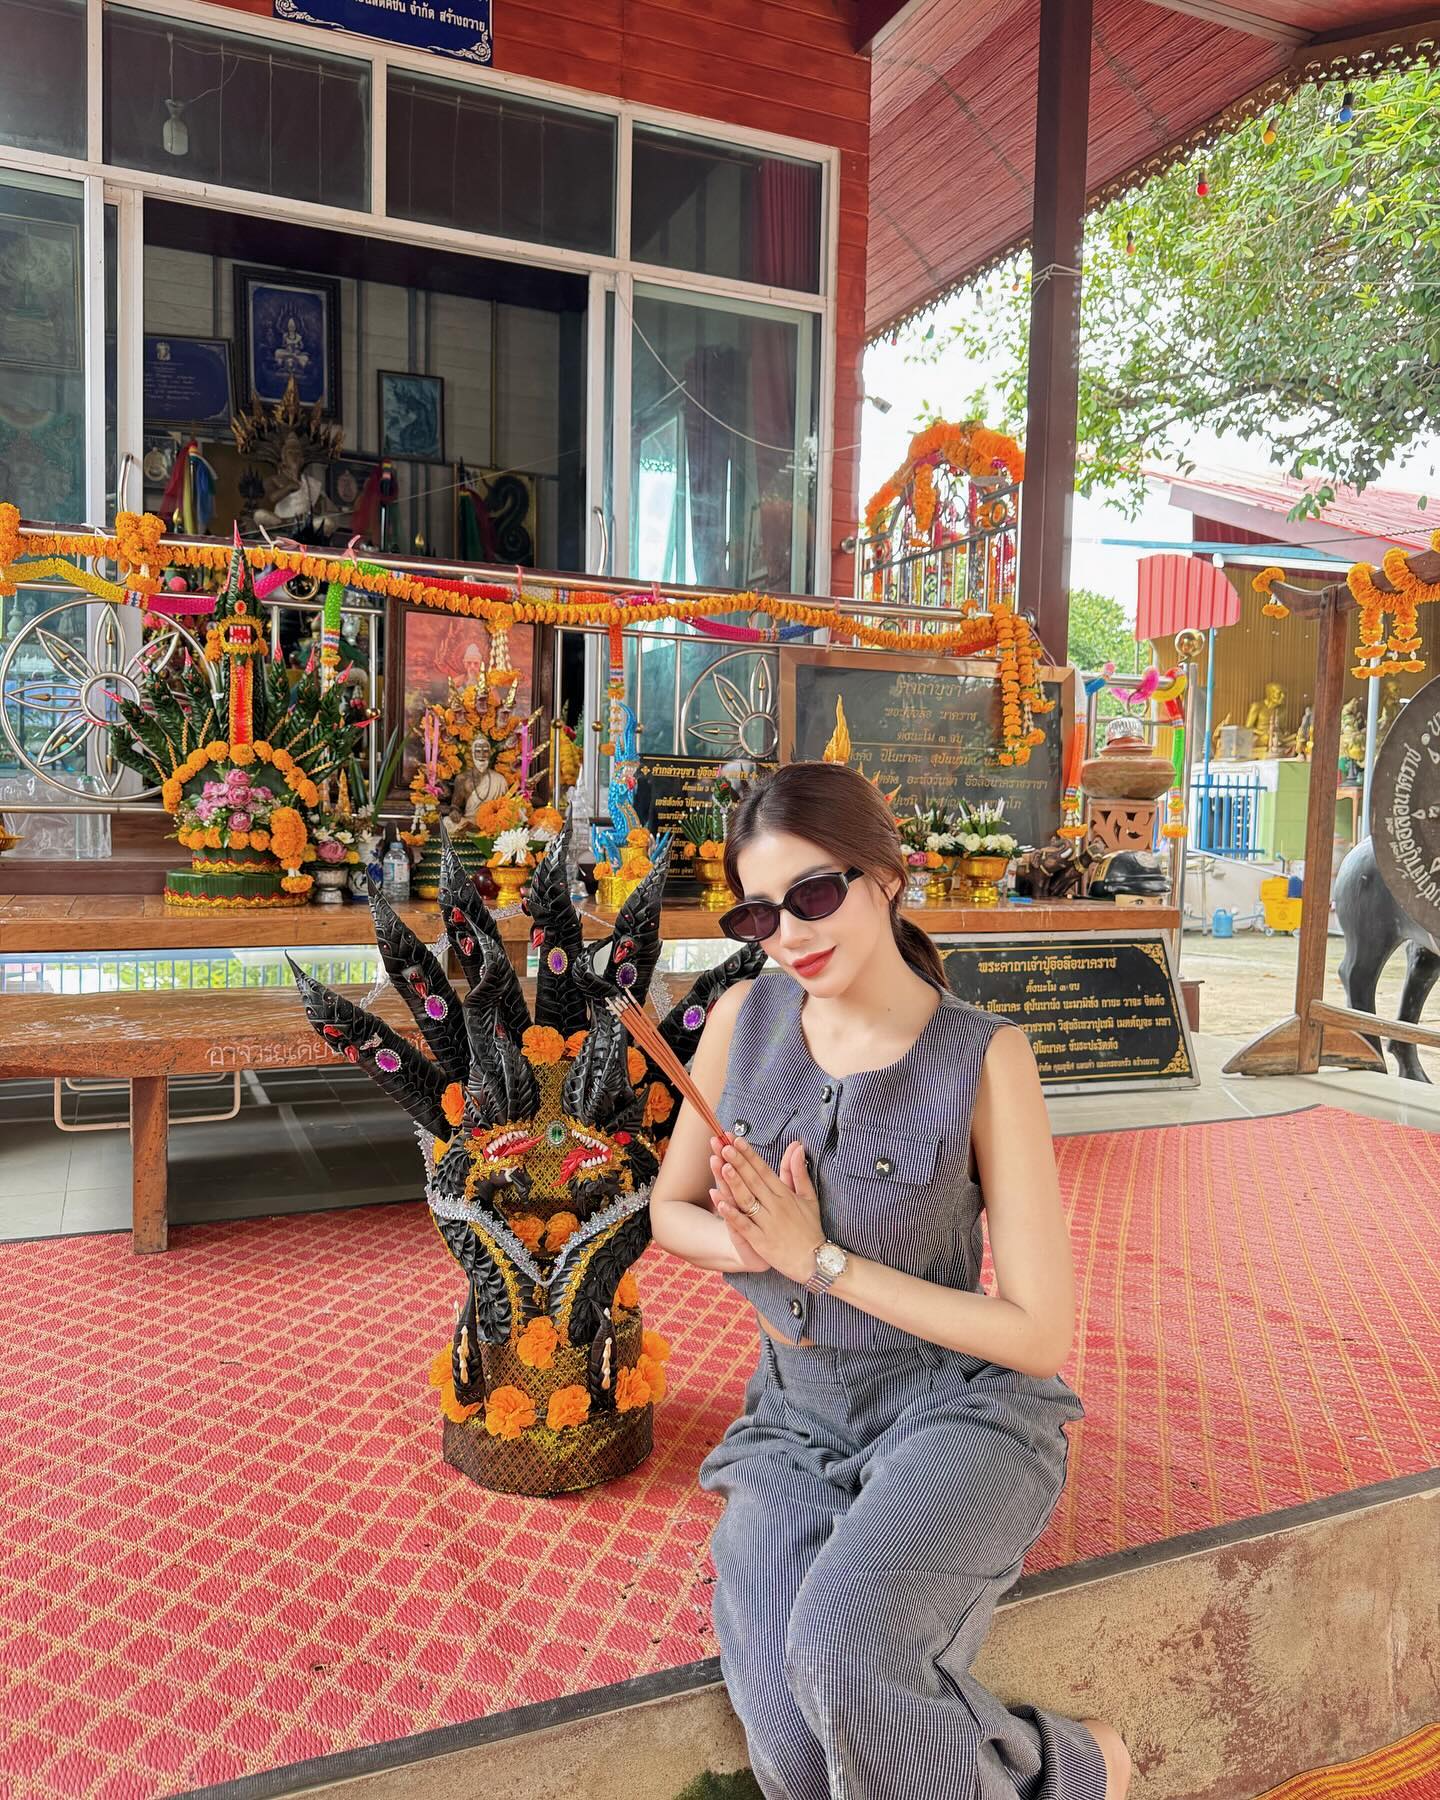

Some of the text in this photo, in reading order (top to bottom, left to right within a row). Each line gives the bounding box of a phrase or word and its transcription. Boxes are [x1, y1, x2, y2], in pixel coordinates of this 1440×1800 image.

[410, 1, 435, 20] จำกัด
[439, 8, 485, 32] สร้างถวาย
